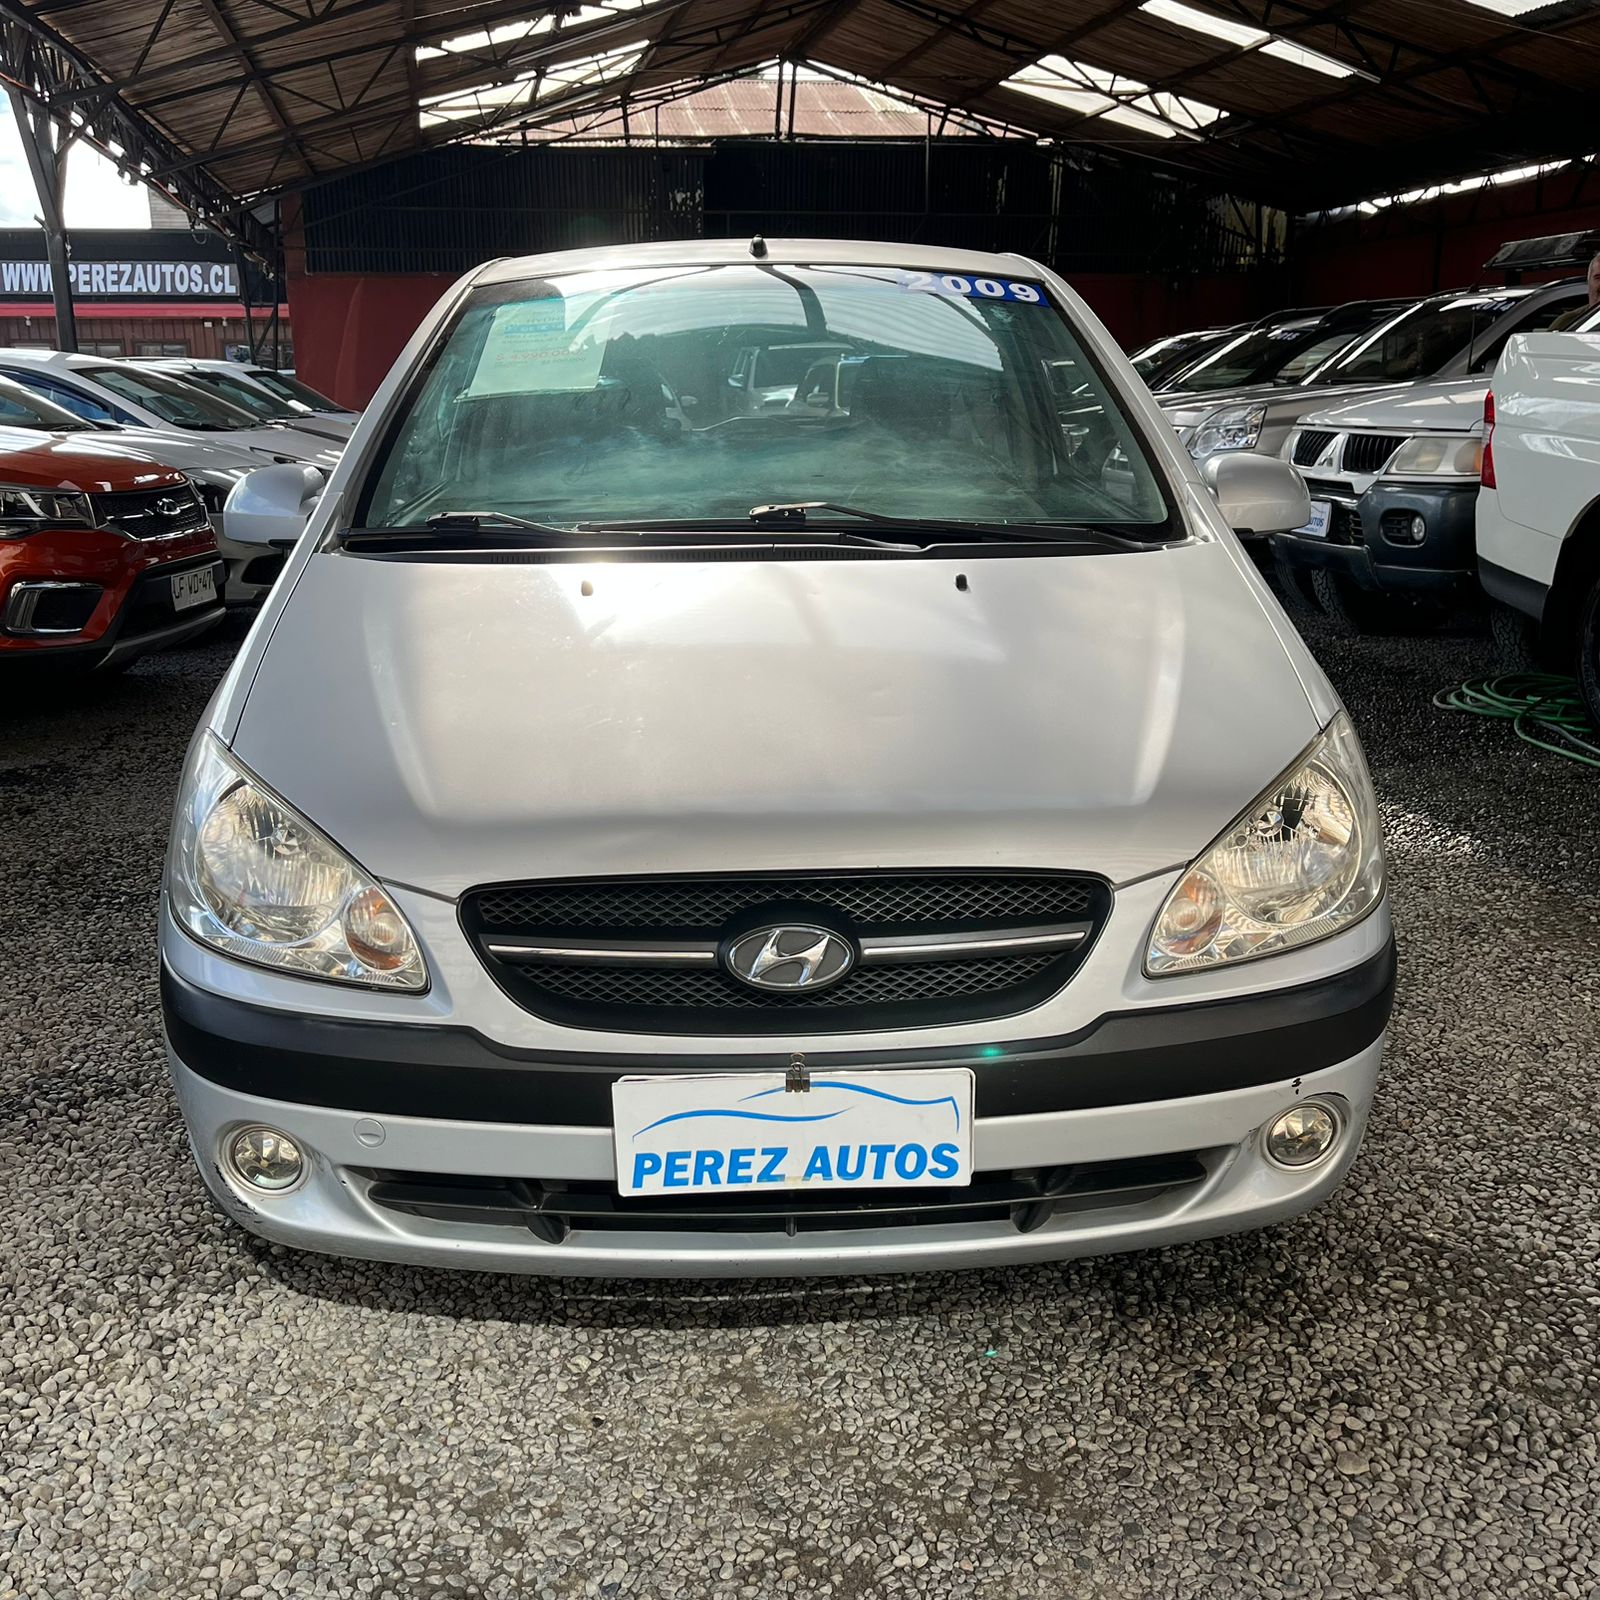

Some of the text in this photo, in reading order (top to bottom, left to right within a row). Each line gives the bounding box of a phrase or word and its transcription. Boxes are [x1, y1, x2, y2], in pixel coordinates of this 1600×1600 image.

[2, 263, 236, 294] WWWPEREZAUTOS.CL
[903, 272, 1040, 303] 2009
[632, 1143, 960, 1189] PEREZ AUTOS
